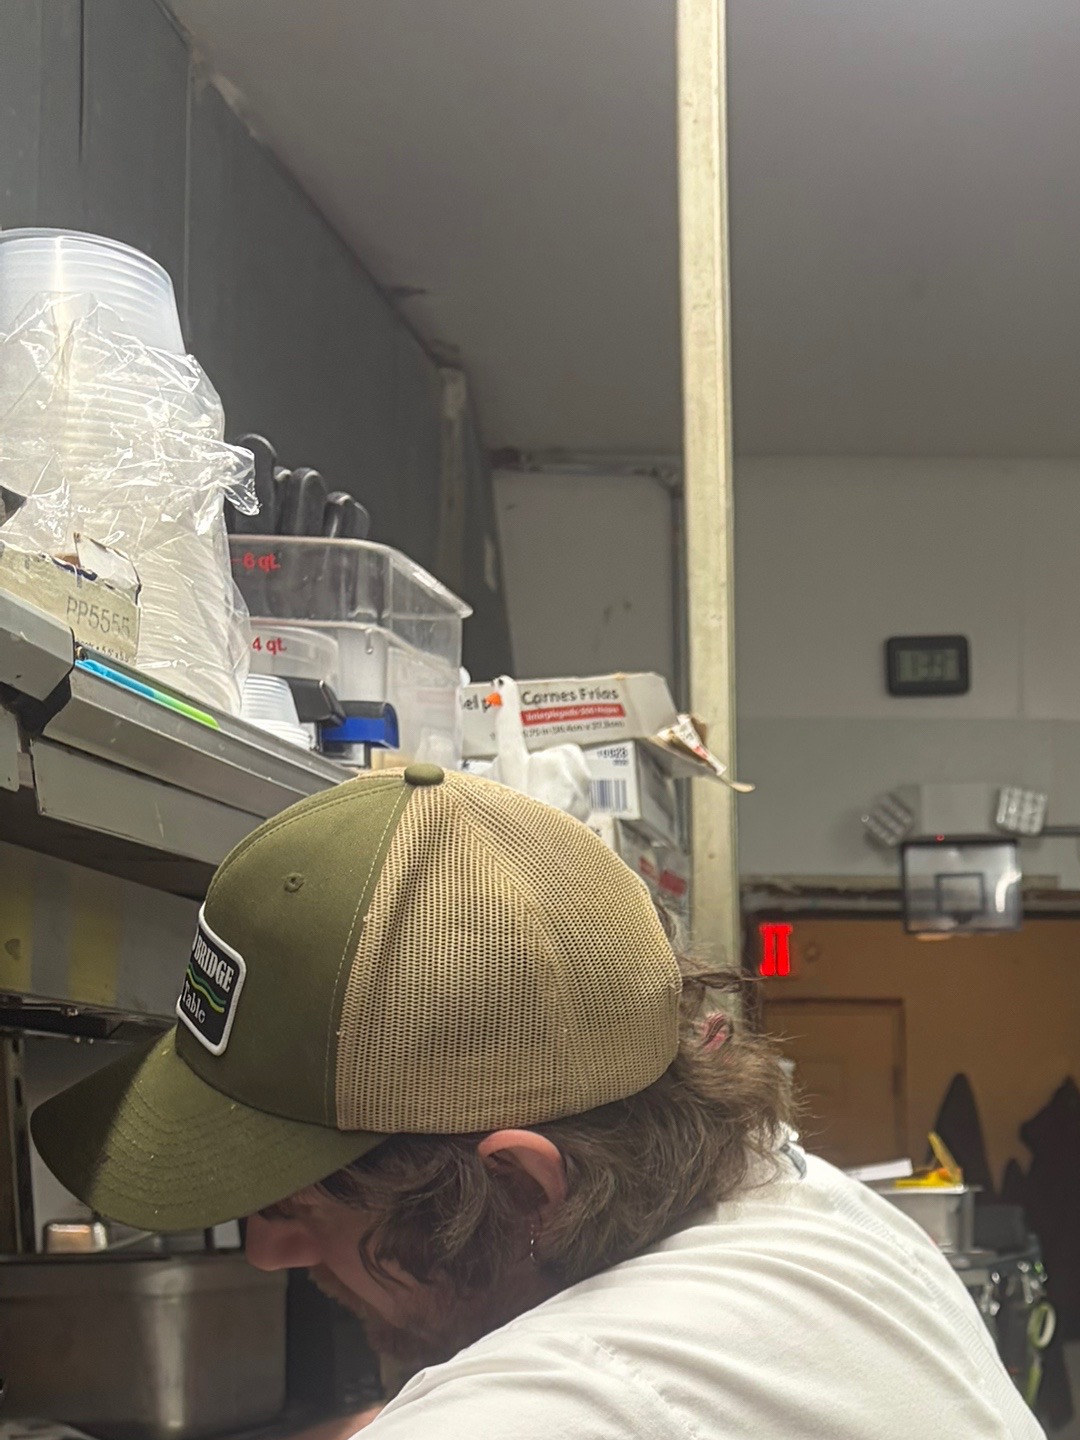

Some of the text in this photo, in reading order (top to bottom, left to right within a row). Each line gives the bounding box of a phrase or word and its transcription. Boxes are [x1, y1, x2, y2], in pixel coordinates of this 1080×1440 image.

[252, 636, 263, 652] 4
[521, 689, 577, 706] Carnes
[192, 925, 235, 993] BRIDGE
[759, 922, 793, 977] IT
[182, 980, 206, 1024] Table
